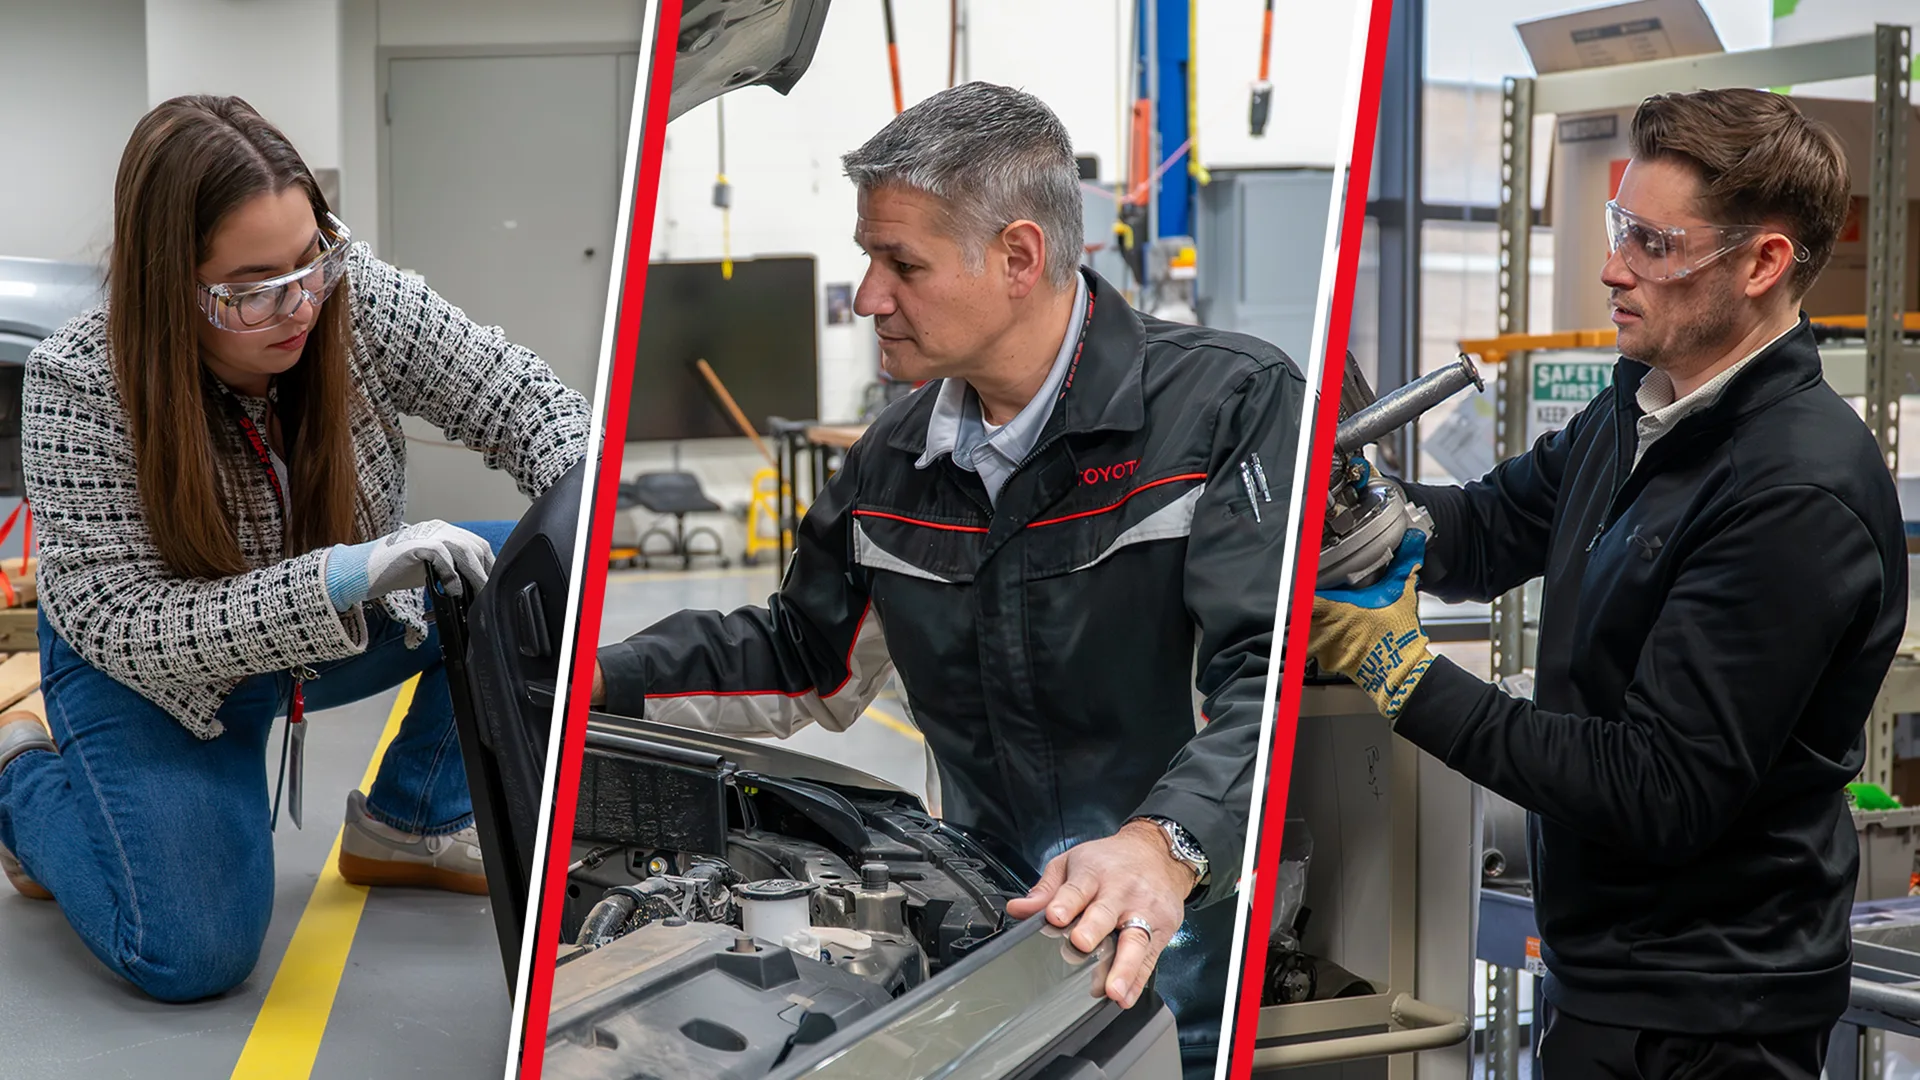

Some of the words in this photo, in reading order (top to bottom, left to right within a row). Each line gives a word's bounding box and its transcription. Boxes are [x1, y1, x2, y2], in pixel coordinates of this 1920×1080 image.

[1538, 364, 1611, 388] SAFETY
[1551, 384, 1598, 400] FIRST
[1537, 406, 1569, 422] KEEP
[240, 416, 270, 464] START
[1356, 630, 1394, 683] TUFF
